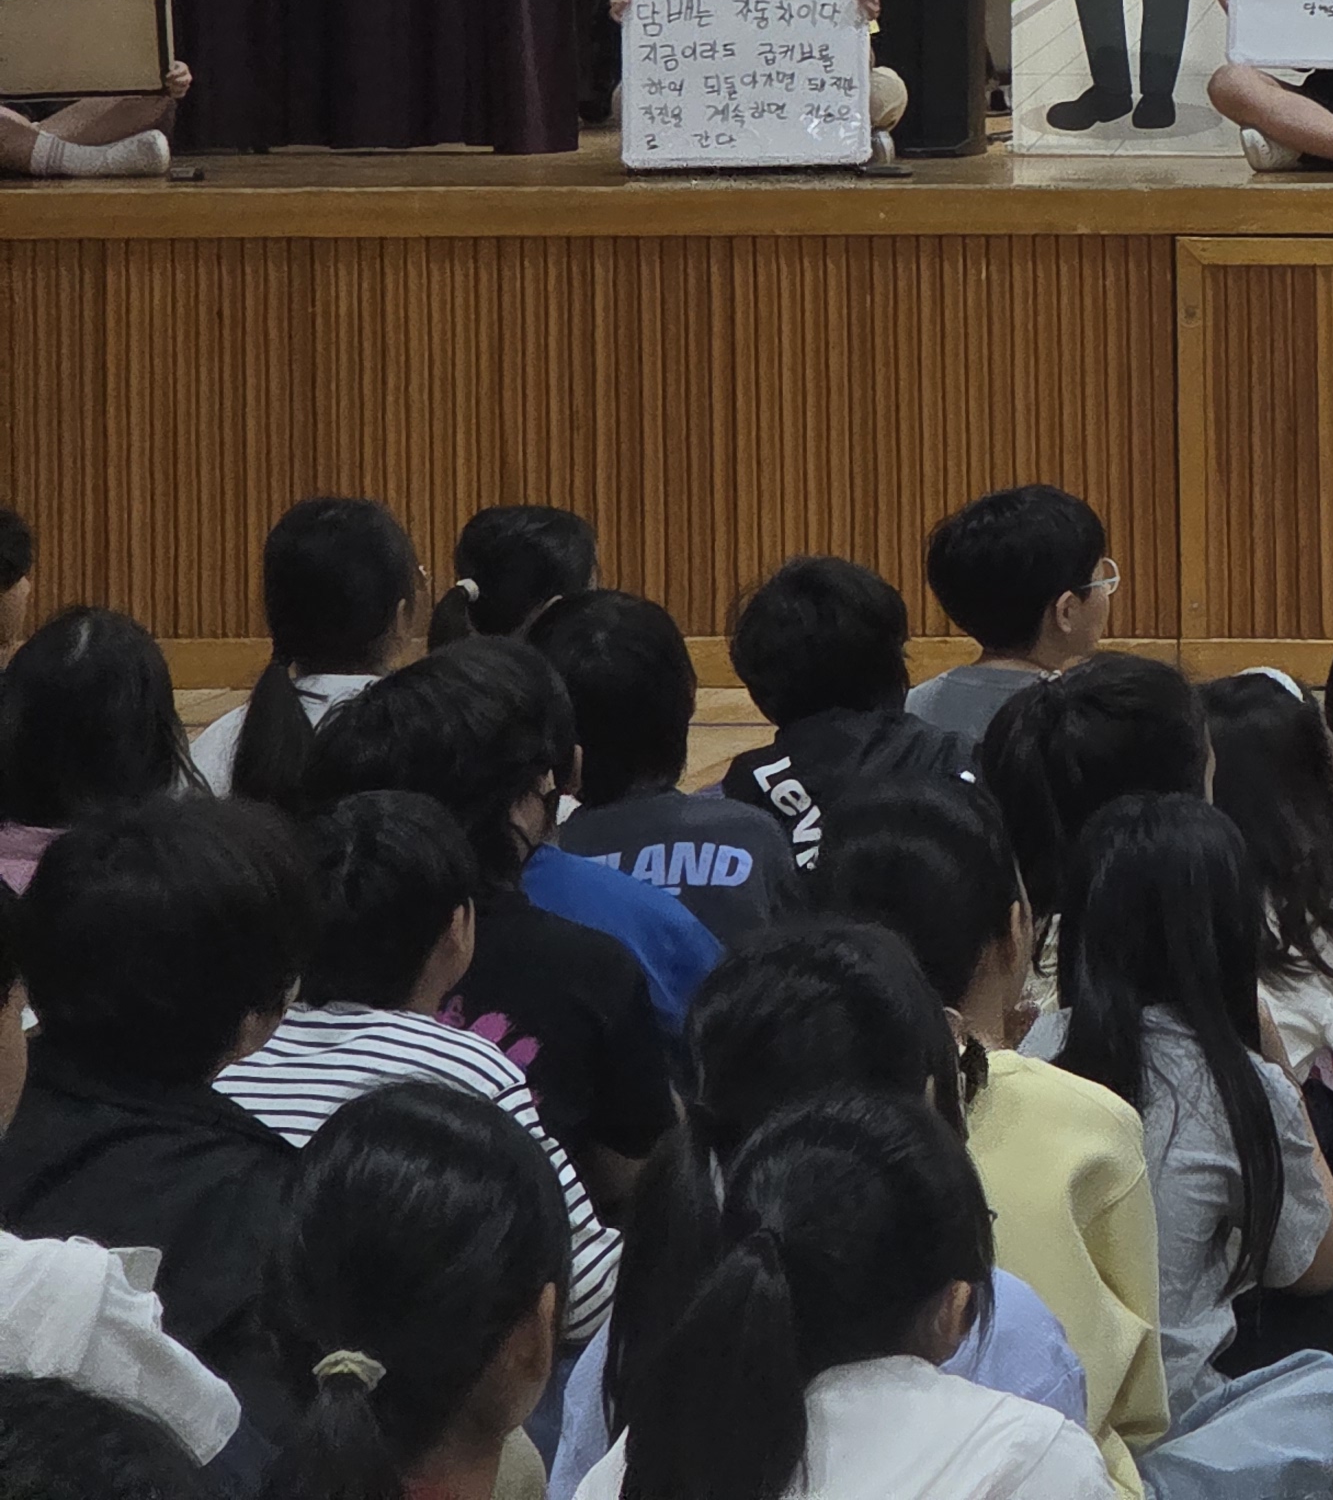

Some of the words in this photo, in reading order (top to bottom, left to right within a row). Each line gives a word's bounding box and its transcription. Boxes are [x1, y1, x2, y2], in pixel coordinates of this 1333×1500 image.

[638, 41, 736, 71] 지금이라도
[757, 42, 835, 73] 급커브를
[642, 77, 684, 96] 하여
[703, 71, 795, 101] 되돌아가면
[639, 103, 684, 128] 직진을
[644, 133, 659, 151] 로
